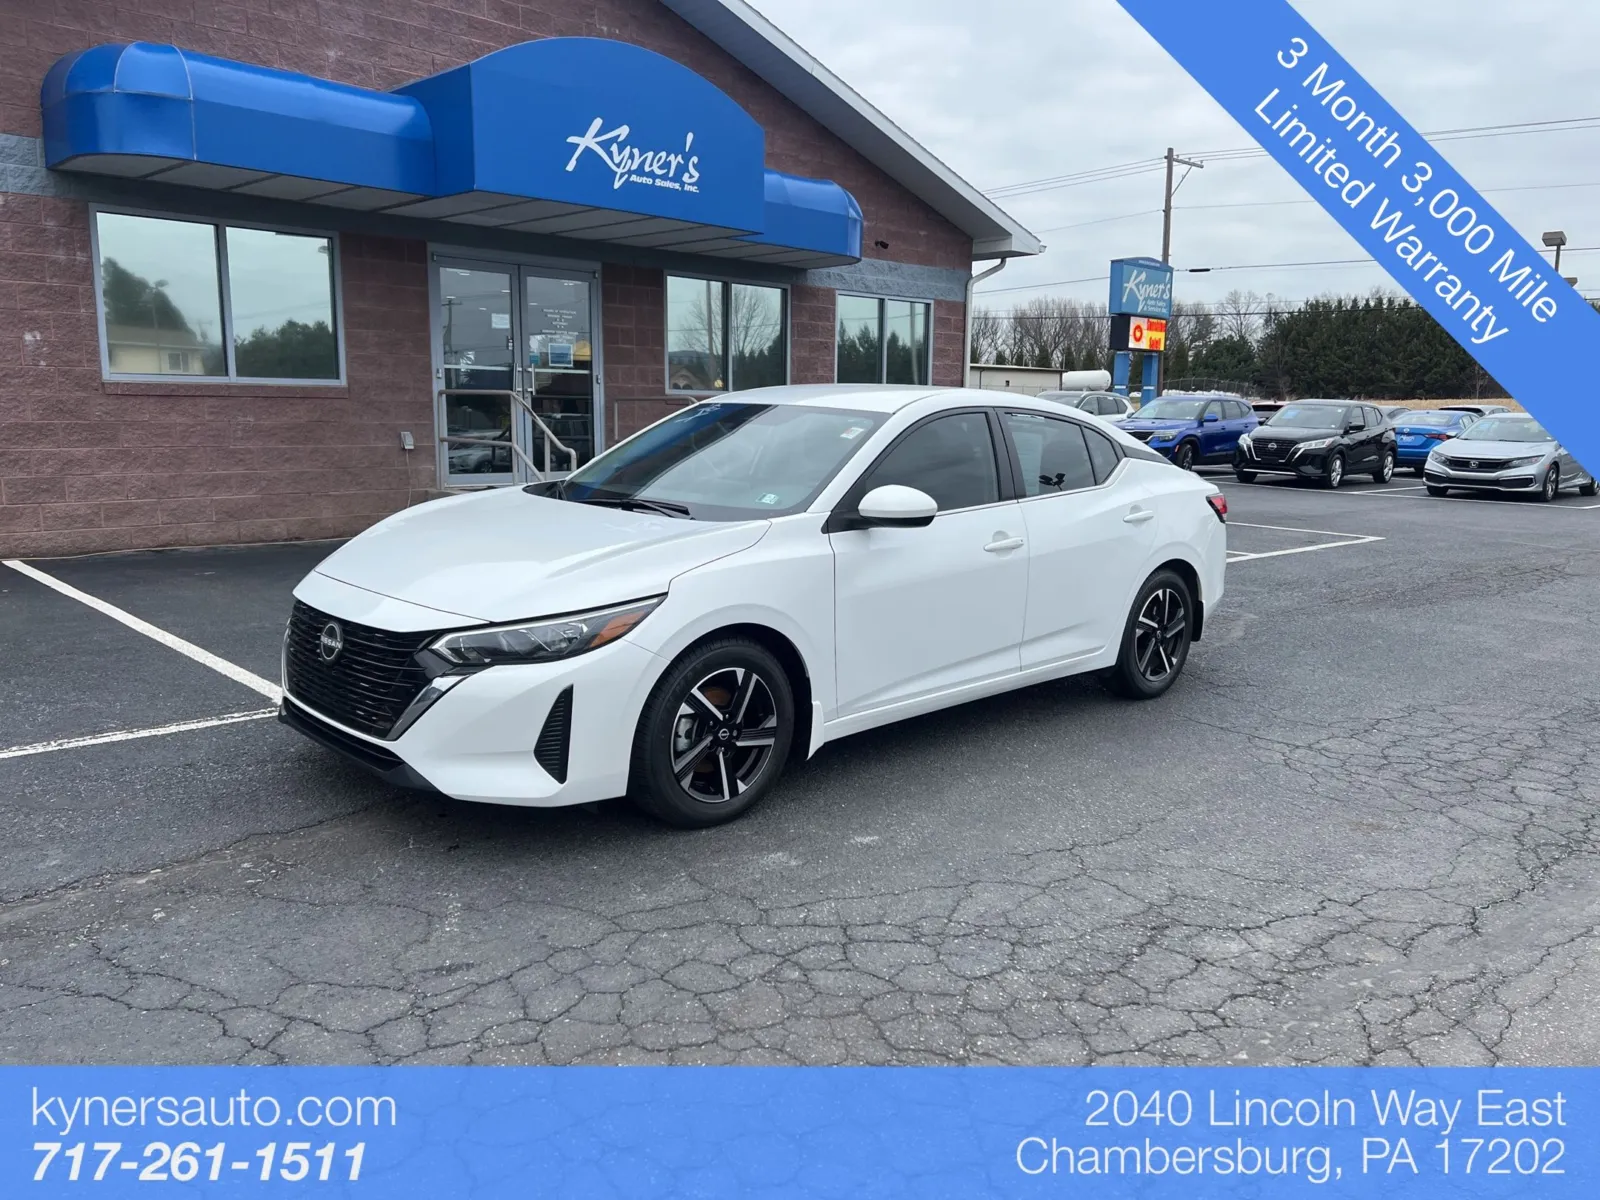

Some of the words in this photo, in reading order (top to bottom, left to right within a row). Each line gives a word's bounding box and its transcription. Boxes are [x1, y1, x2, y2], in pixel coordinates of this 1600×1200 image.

[565, 117, 700, 190] Kyner's
[629, 174, 653, 185] Auto
[654, 178, 682, 191] Sales,
[683, 183, 700, 193] Inc.
[1122, 269, 1171, 313] Kyner's
[321, 635, 342, 649] SSAN
